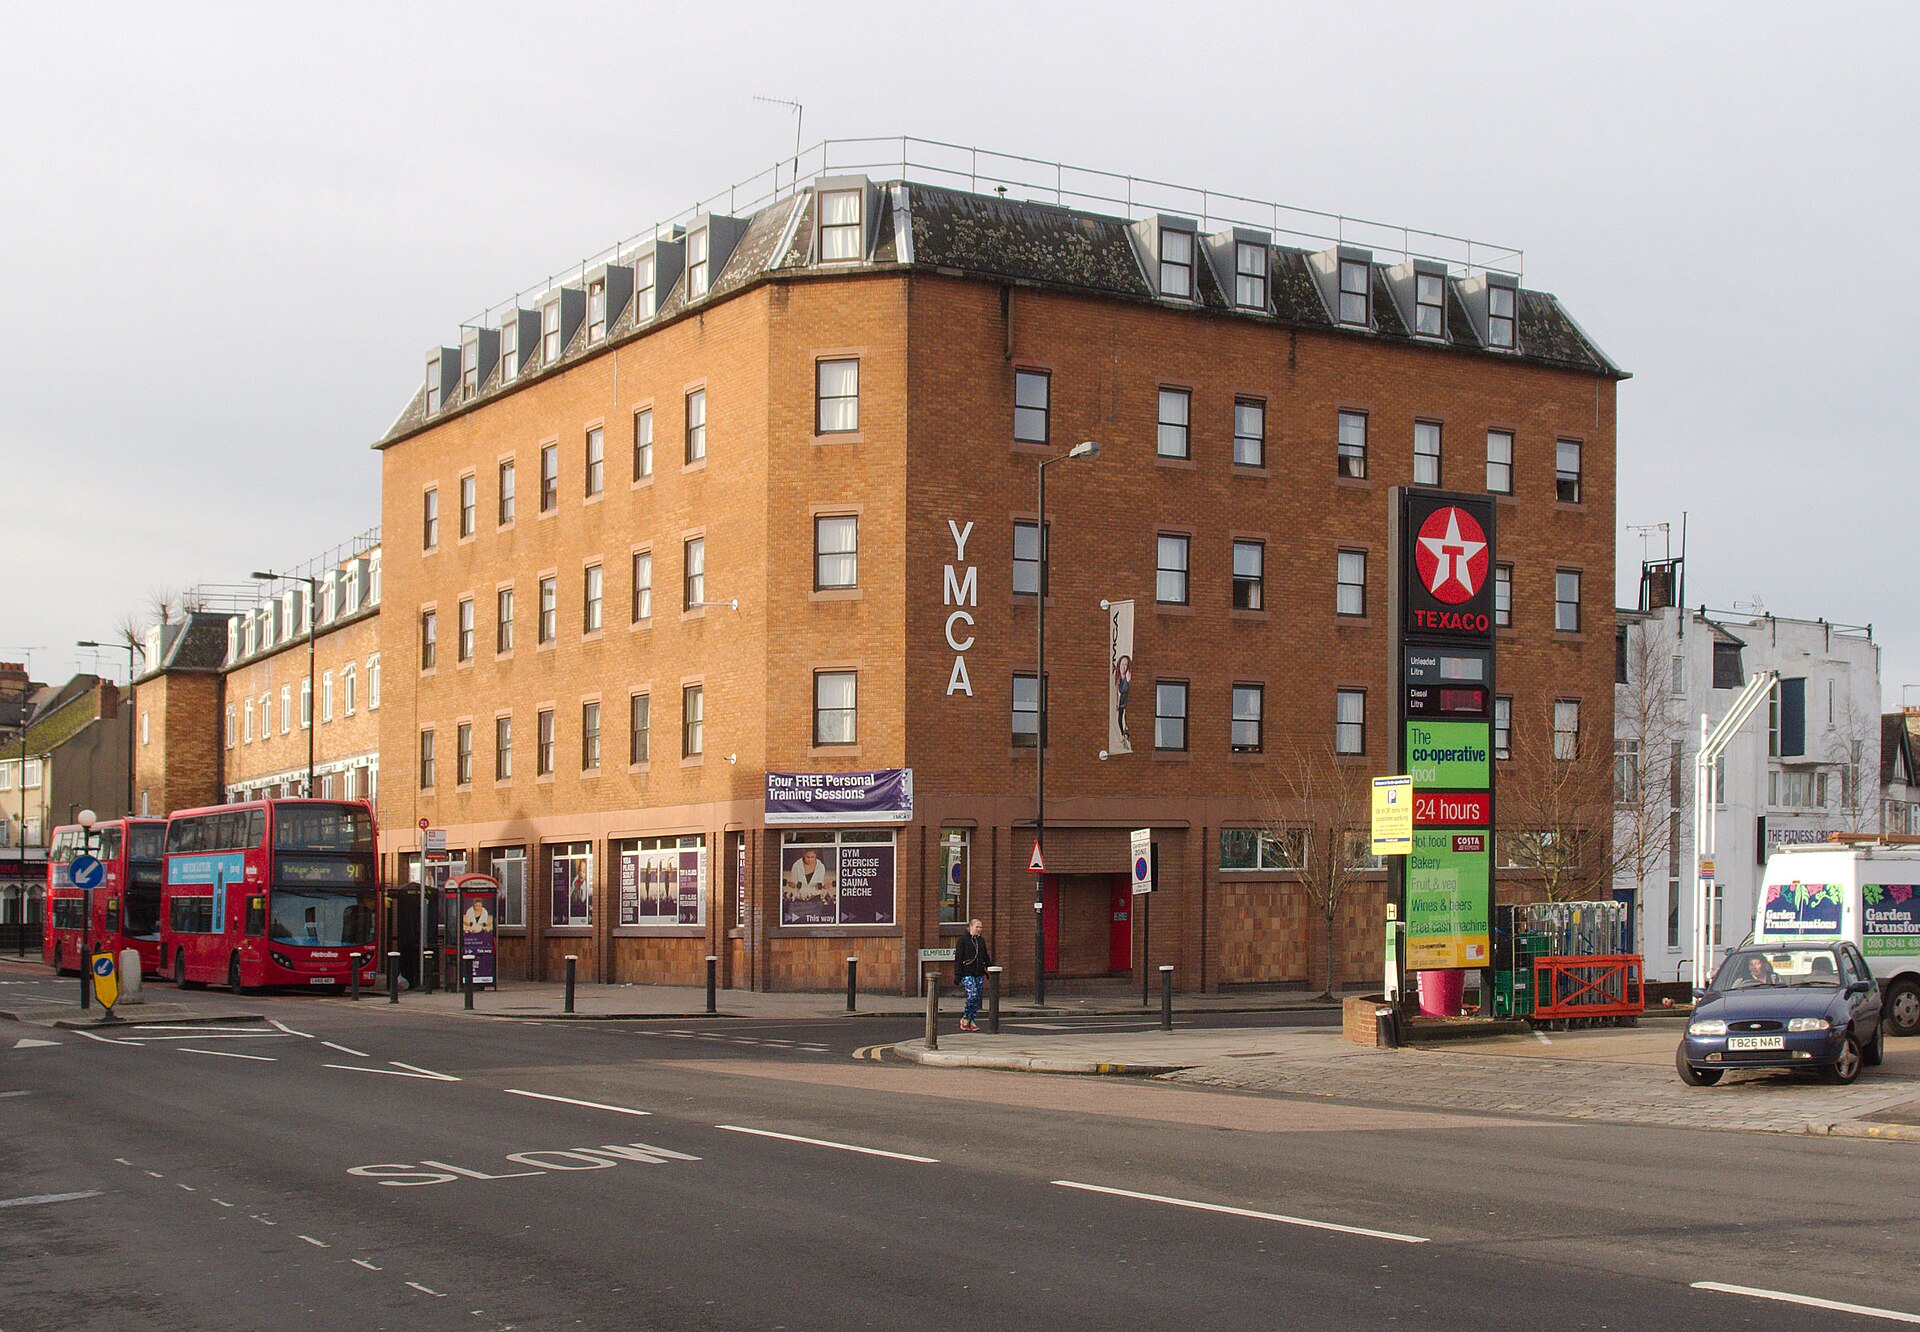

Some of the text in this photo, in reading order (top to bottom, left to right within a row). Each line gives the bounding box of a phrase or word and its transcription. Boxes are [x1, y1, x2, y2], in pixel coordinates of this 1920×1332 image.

[943, 520, 978, 697] YMCA
[1414, 609, 1489, 632] TEXACO
[1111, 610, 1120, 675] YMCA
[1410, 657, 1436, 666] Unleaded
[1410, 667, 1424, 675] Litre
[1410, 689, 1428, 698] Diesel
[1410, 700, 1424, 708] Litre
[1411, 728, 1432, 745] The
[1412, 746, 1486, 764] co-operative
[768, 773, 875, 787] Four FREE Personal
[1412, 766, 1436, 783] food
[768, 788, 865, 802] Training Sessions
[1416, 799, 1480, 820] 24 hours
[1428, 835, 1447, 848] food
[1457, 837, 1480, 845] COSTA
[1768, 829, 1783, 842] THE
[1784, 829, 1815, 842] FITNESS
[841, 849, 860, 858] GYM
[841, 858, 880, 868] EXERCISE
[1411, 856, 1441, 870] Bakery
[346, 864, 359, 878] 91
[841, 868, 877, 877] CLASSES
[841, 878, 869, 887] SAUNA
[1411, 878, 1457, 893] Fruit & veg
[1412, 899, 1473, 912] Wines & beers
[806, 914, 835, 924] This way
[1766, 910, 1796, 920] Garden
[1865, 908, 1912, 921] Garden
[1411, 919, 1487, 933] Free cash machine
[1765, 919, 1837, 929] Transformations
[1865, 921, 1920, 933] Transfor
[1867, 938, 1884, 948] 020
[1886, 938, 1905, 948] 8341
[1730, 1037, 1781, 1048] T826 NAR
[346, 1142, 703, 1186] SLOW
